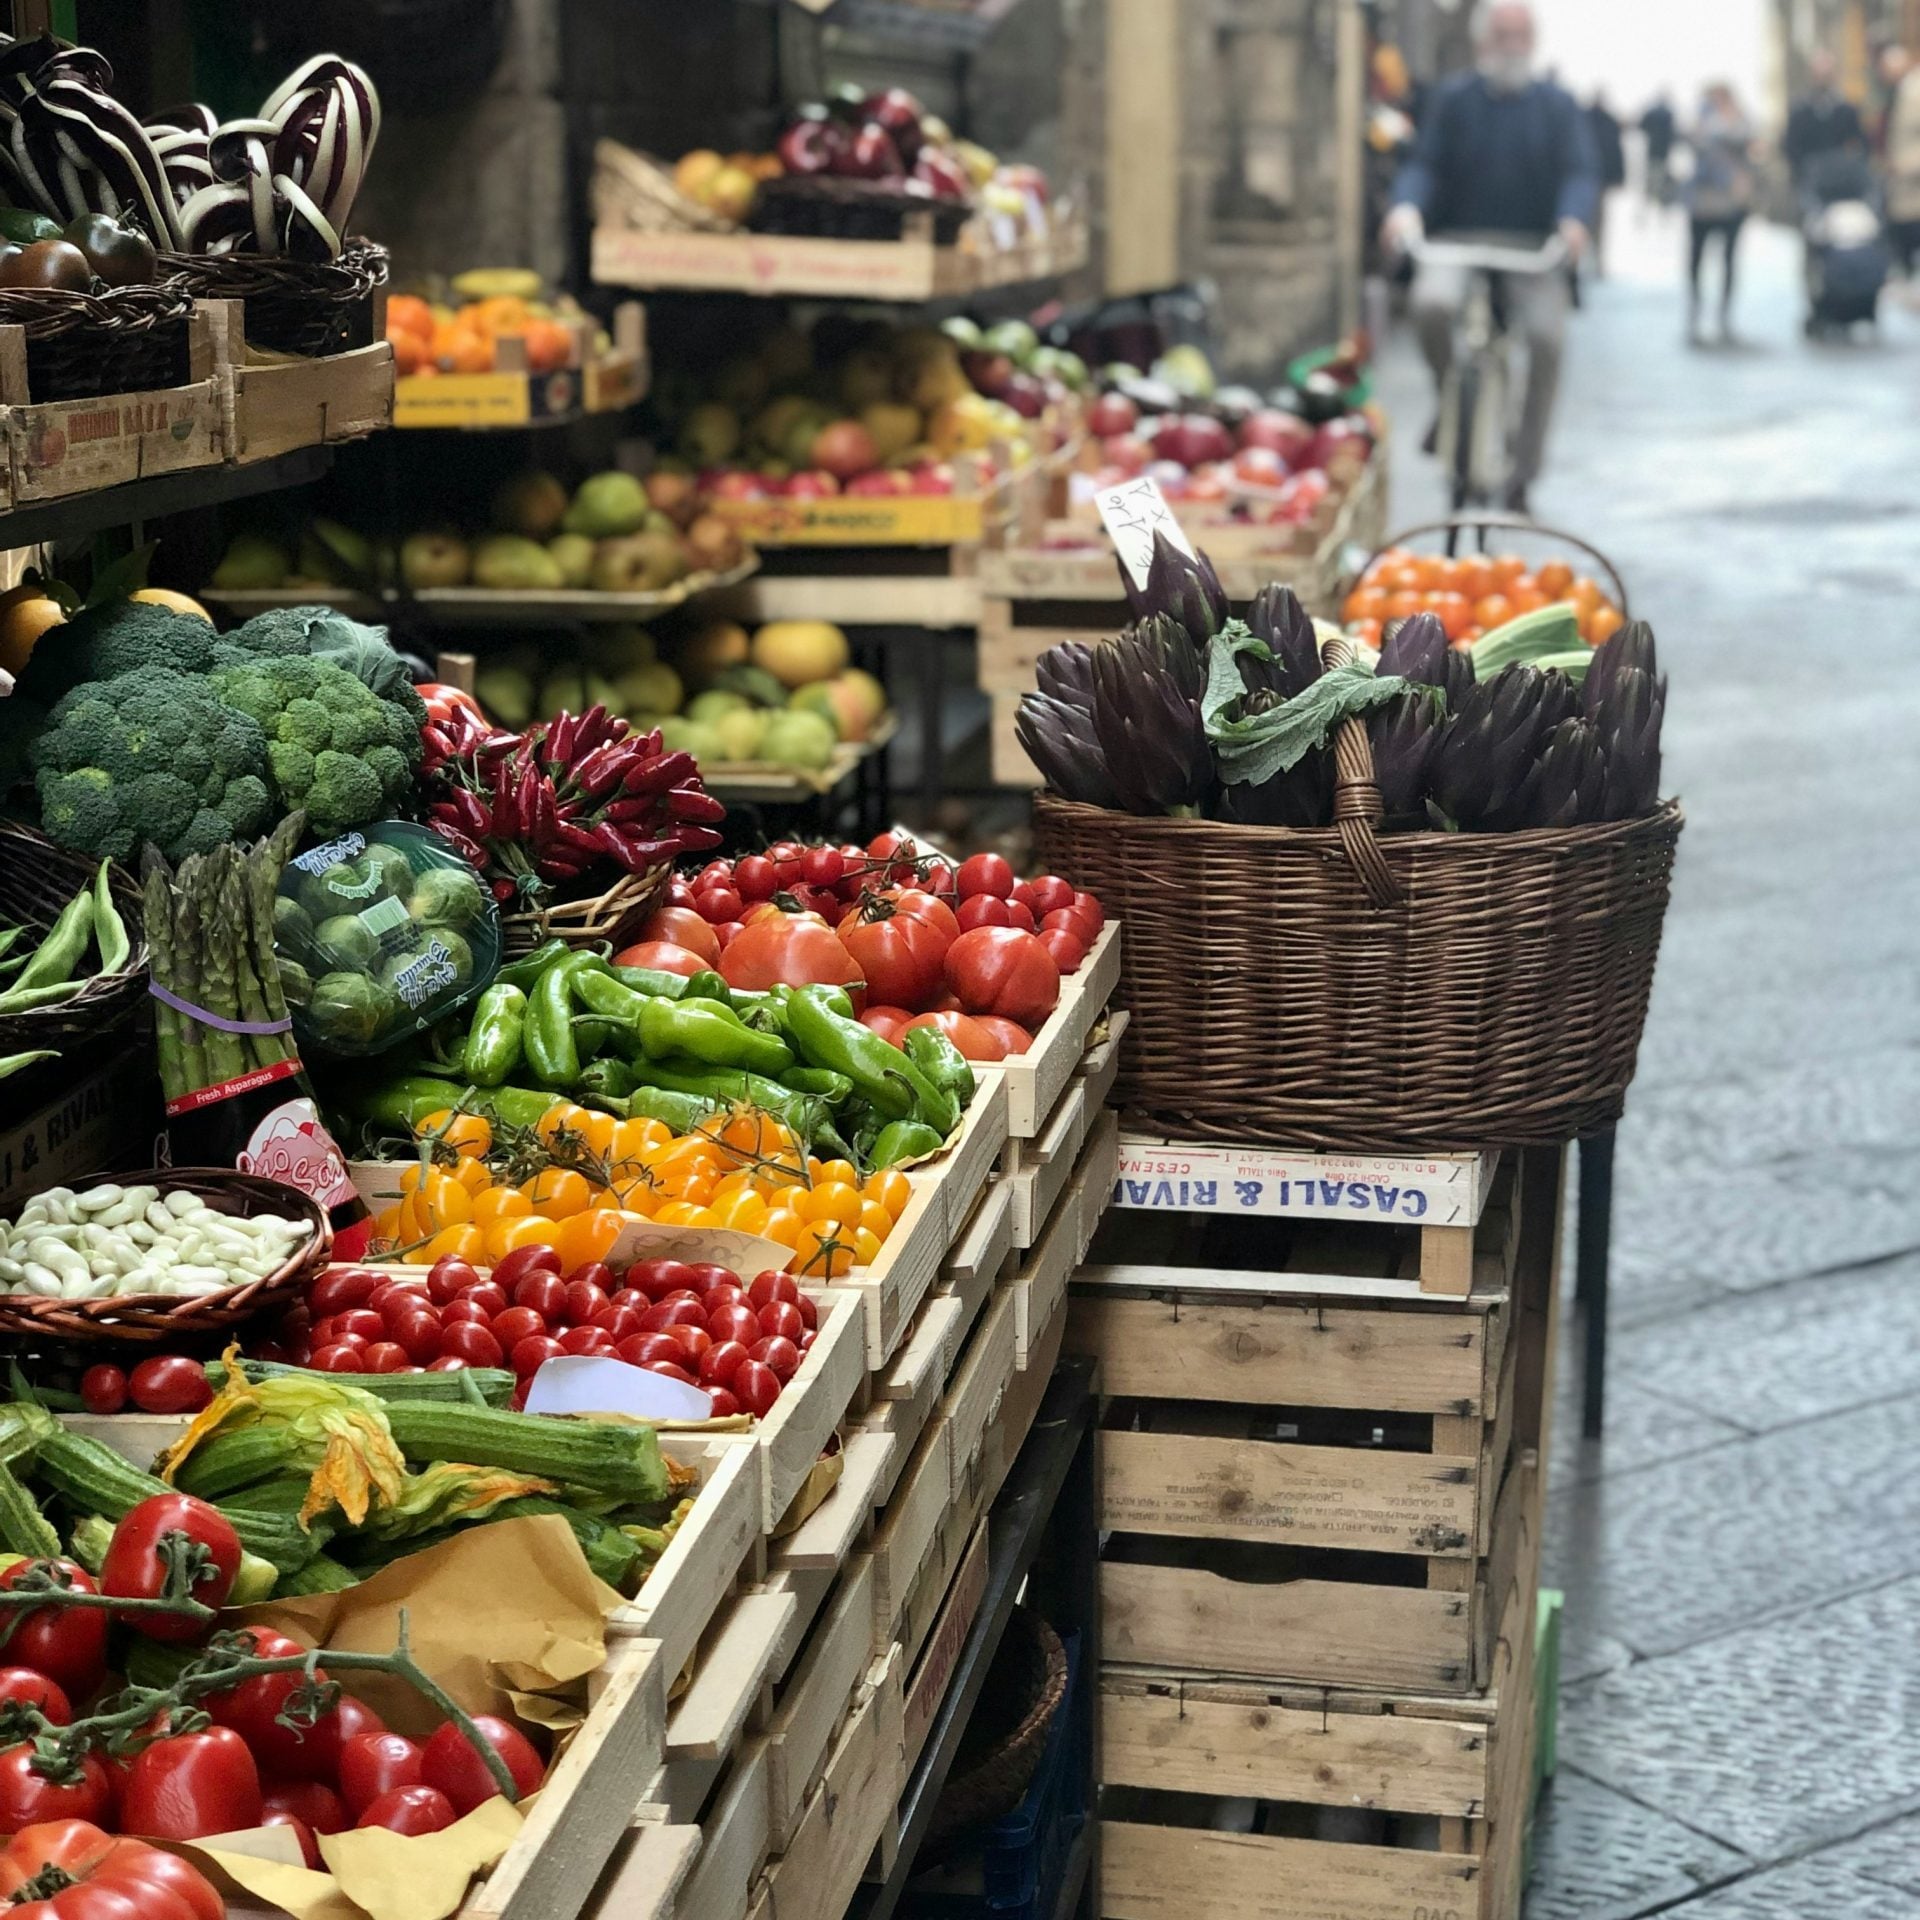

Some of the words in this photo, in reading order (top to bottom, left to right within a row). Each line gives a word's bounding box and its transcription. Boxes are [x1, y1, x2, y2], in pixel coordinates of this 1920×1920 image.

[331, 883, 368, 898] Andrea
[196, 1089, 221, 1103] Fresh
[224, 1072, 273, 1094] Asparagus
[1119, 1160, 1190, 1174] CESENA
[1238, 1167, 1263, 1177] ITALIA
[1361, 1174, 1389, 1183] CACHI
[1234, 1181, 1263, 1206] &
[1281, 1181, 1427, 1218] CASALI
